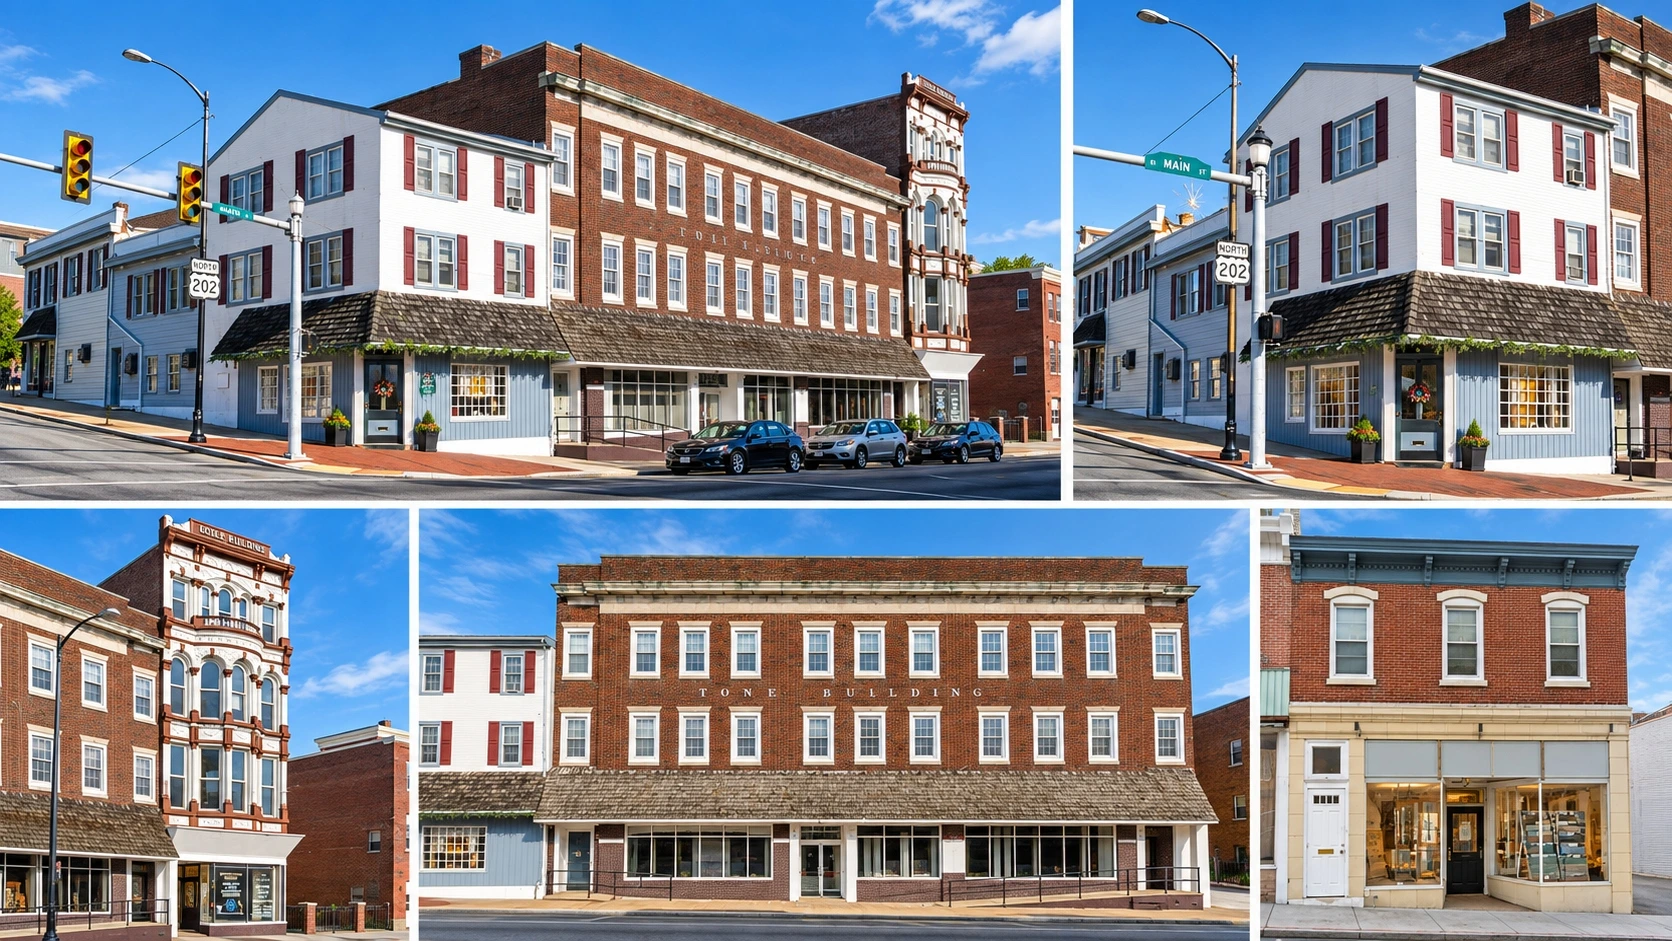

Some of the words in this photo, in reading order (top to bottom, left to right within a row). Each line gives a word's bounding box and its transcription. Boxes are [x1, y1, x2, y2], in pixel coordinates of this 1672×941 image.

[1163, 158, 1191, 172] MAIN
[1219, 244, 1247, 255] NORTH
[1219, 262, 1247, 279] 202
[192, 278, 217, 294] 202
[698, 687, 777, 698] TONE
